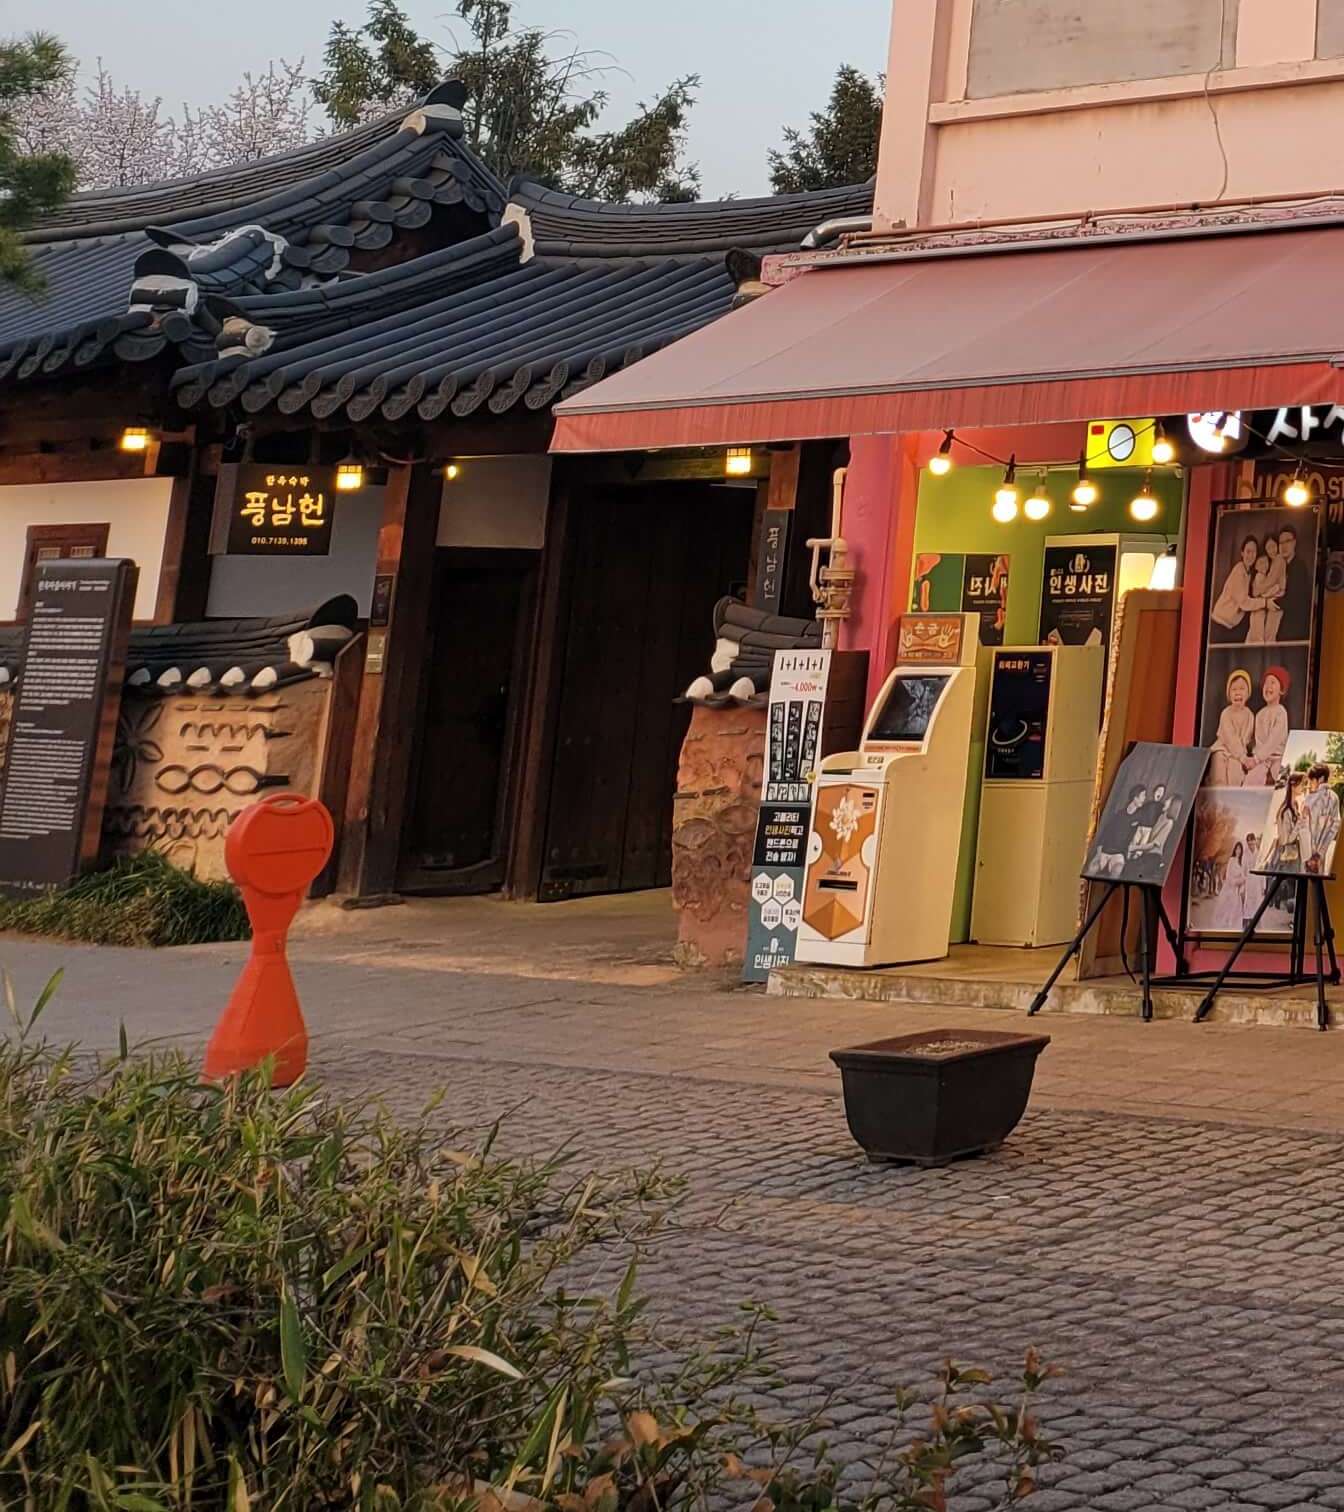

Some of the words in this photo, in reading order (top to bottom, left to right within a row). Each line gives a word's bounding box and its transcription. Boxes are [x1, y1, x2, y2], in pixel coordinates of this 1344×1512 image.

[240, 491, 324, 526] 풍남헌
[1049, 575, 1110, 595] 인생사진
[780, 656, 823, 671] 1+1+1+1
